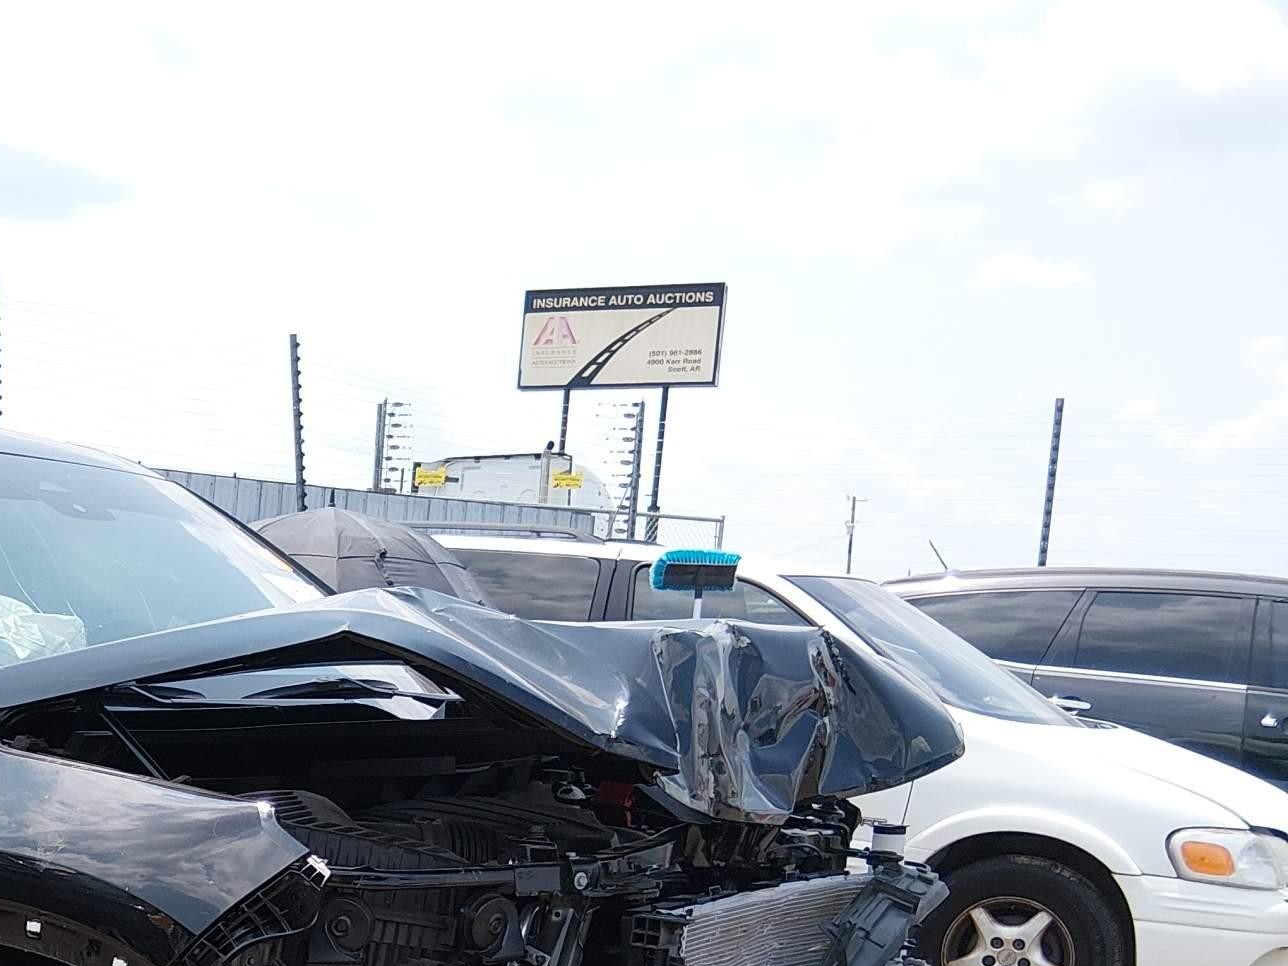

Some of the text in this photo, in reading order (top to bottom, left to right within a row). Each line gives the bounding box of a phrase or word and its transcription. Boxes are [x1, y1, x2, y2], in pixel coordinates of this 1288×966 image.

[532, 291, 715, 309] INSURANCE AUTO AUCTIONS
[648, 350, 667, 359] (501)
[682, 357, 702, 365] Road
